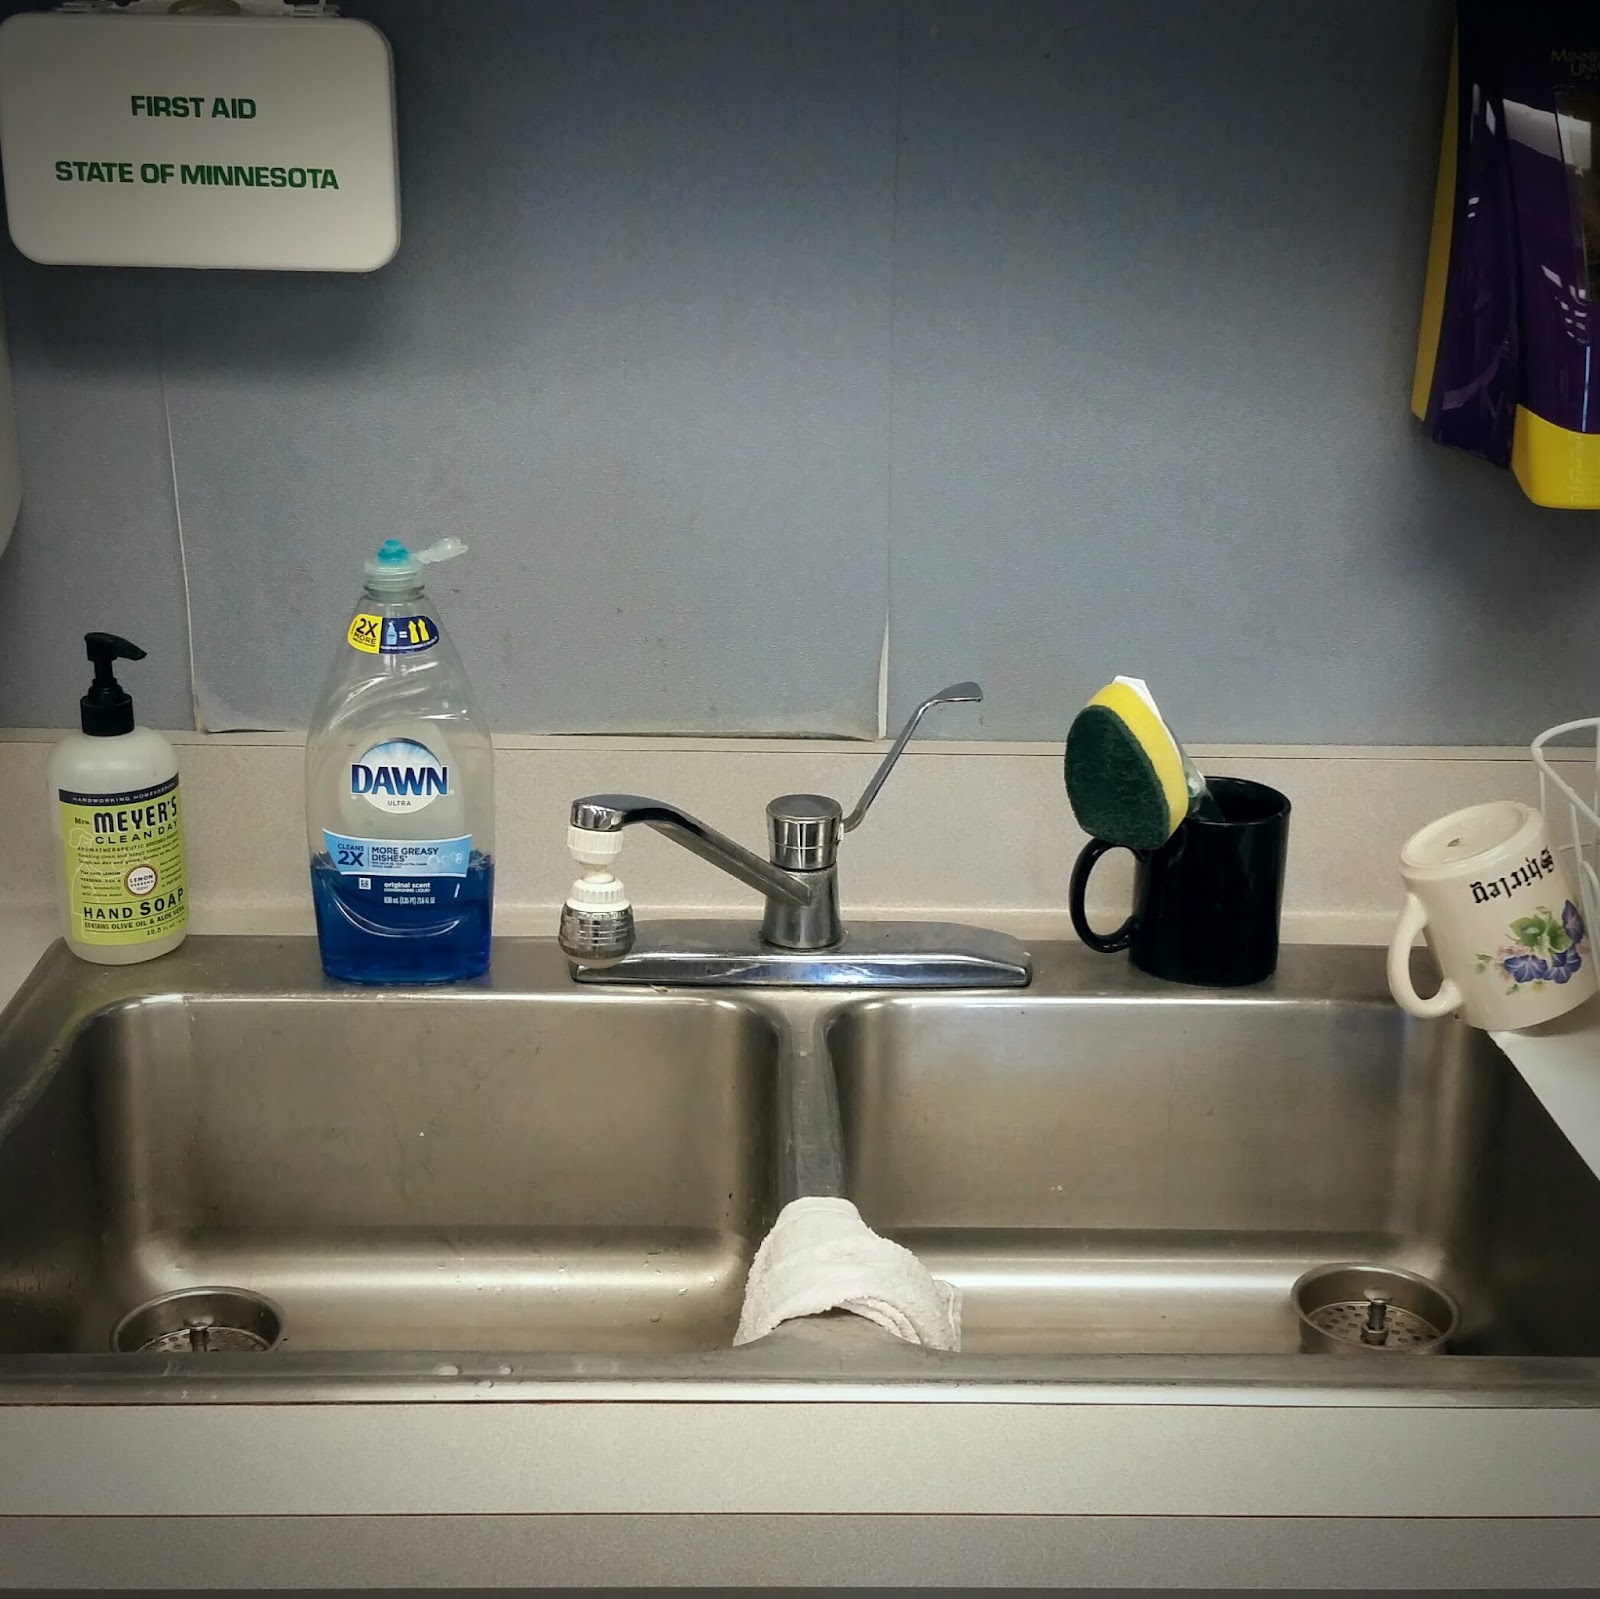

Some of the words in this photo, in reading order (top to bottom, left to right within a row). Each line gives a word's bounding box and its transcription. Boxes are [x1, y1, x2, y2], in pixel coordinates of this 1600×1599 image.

[131, 95, 205, 118] FIRST
[211, 97, 256, 119] AID
[55, 161, 134, 183] STATE
[140, 163, 174, 184] OF
[181, 164, 339, 190] MINNESOTA
[355, 618, 378, 638] 2X
[353, 632, 377, 645] MORE
[351, 764, 448, 796] DAWN
[74, 817, 91, 825] Mrs.
[94, 795, 178, 833] MEYER'S
[95, 830, 152, 844] CLEAN
[158, 819, 178, 835] DAY
[77, 843, 144, 853] AROMATHERAPEUTIC
[337, 843, 364, 851] CLEANS
[371, 847, 399, 855] MORE
[400, 847, 439, 856] GREASY
[337, 851, 364, 867] 2X
[129, 874, 153, 883] LEMON
[1469, 846, 1555, 904] Shirley
[83, 906, 133, 919] HAND
[140, 888, 184, 916] SOAP
[85, 922, 109, 930] CONTAINS
[111, 921, 133, 930] OLIVE
[135, 919, 148, 927] OIL
[149, 917, 154, 925] &
[157, 912, 172, 923] ALOE
